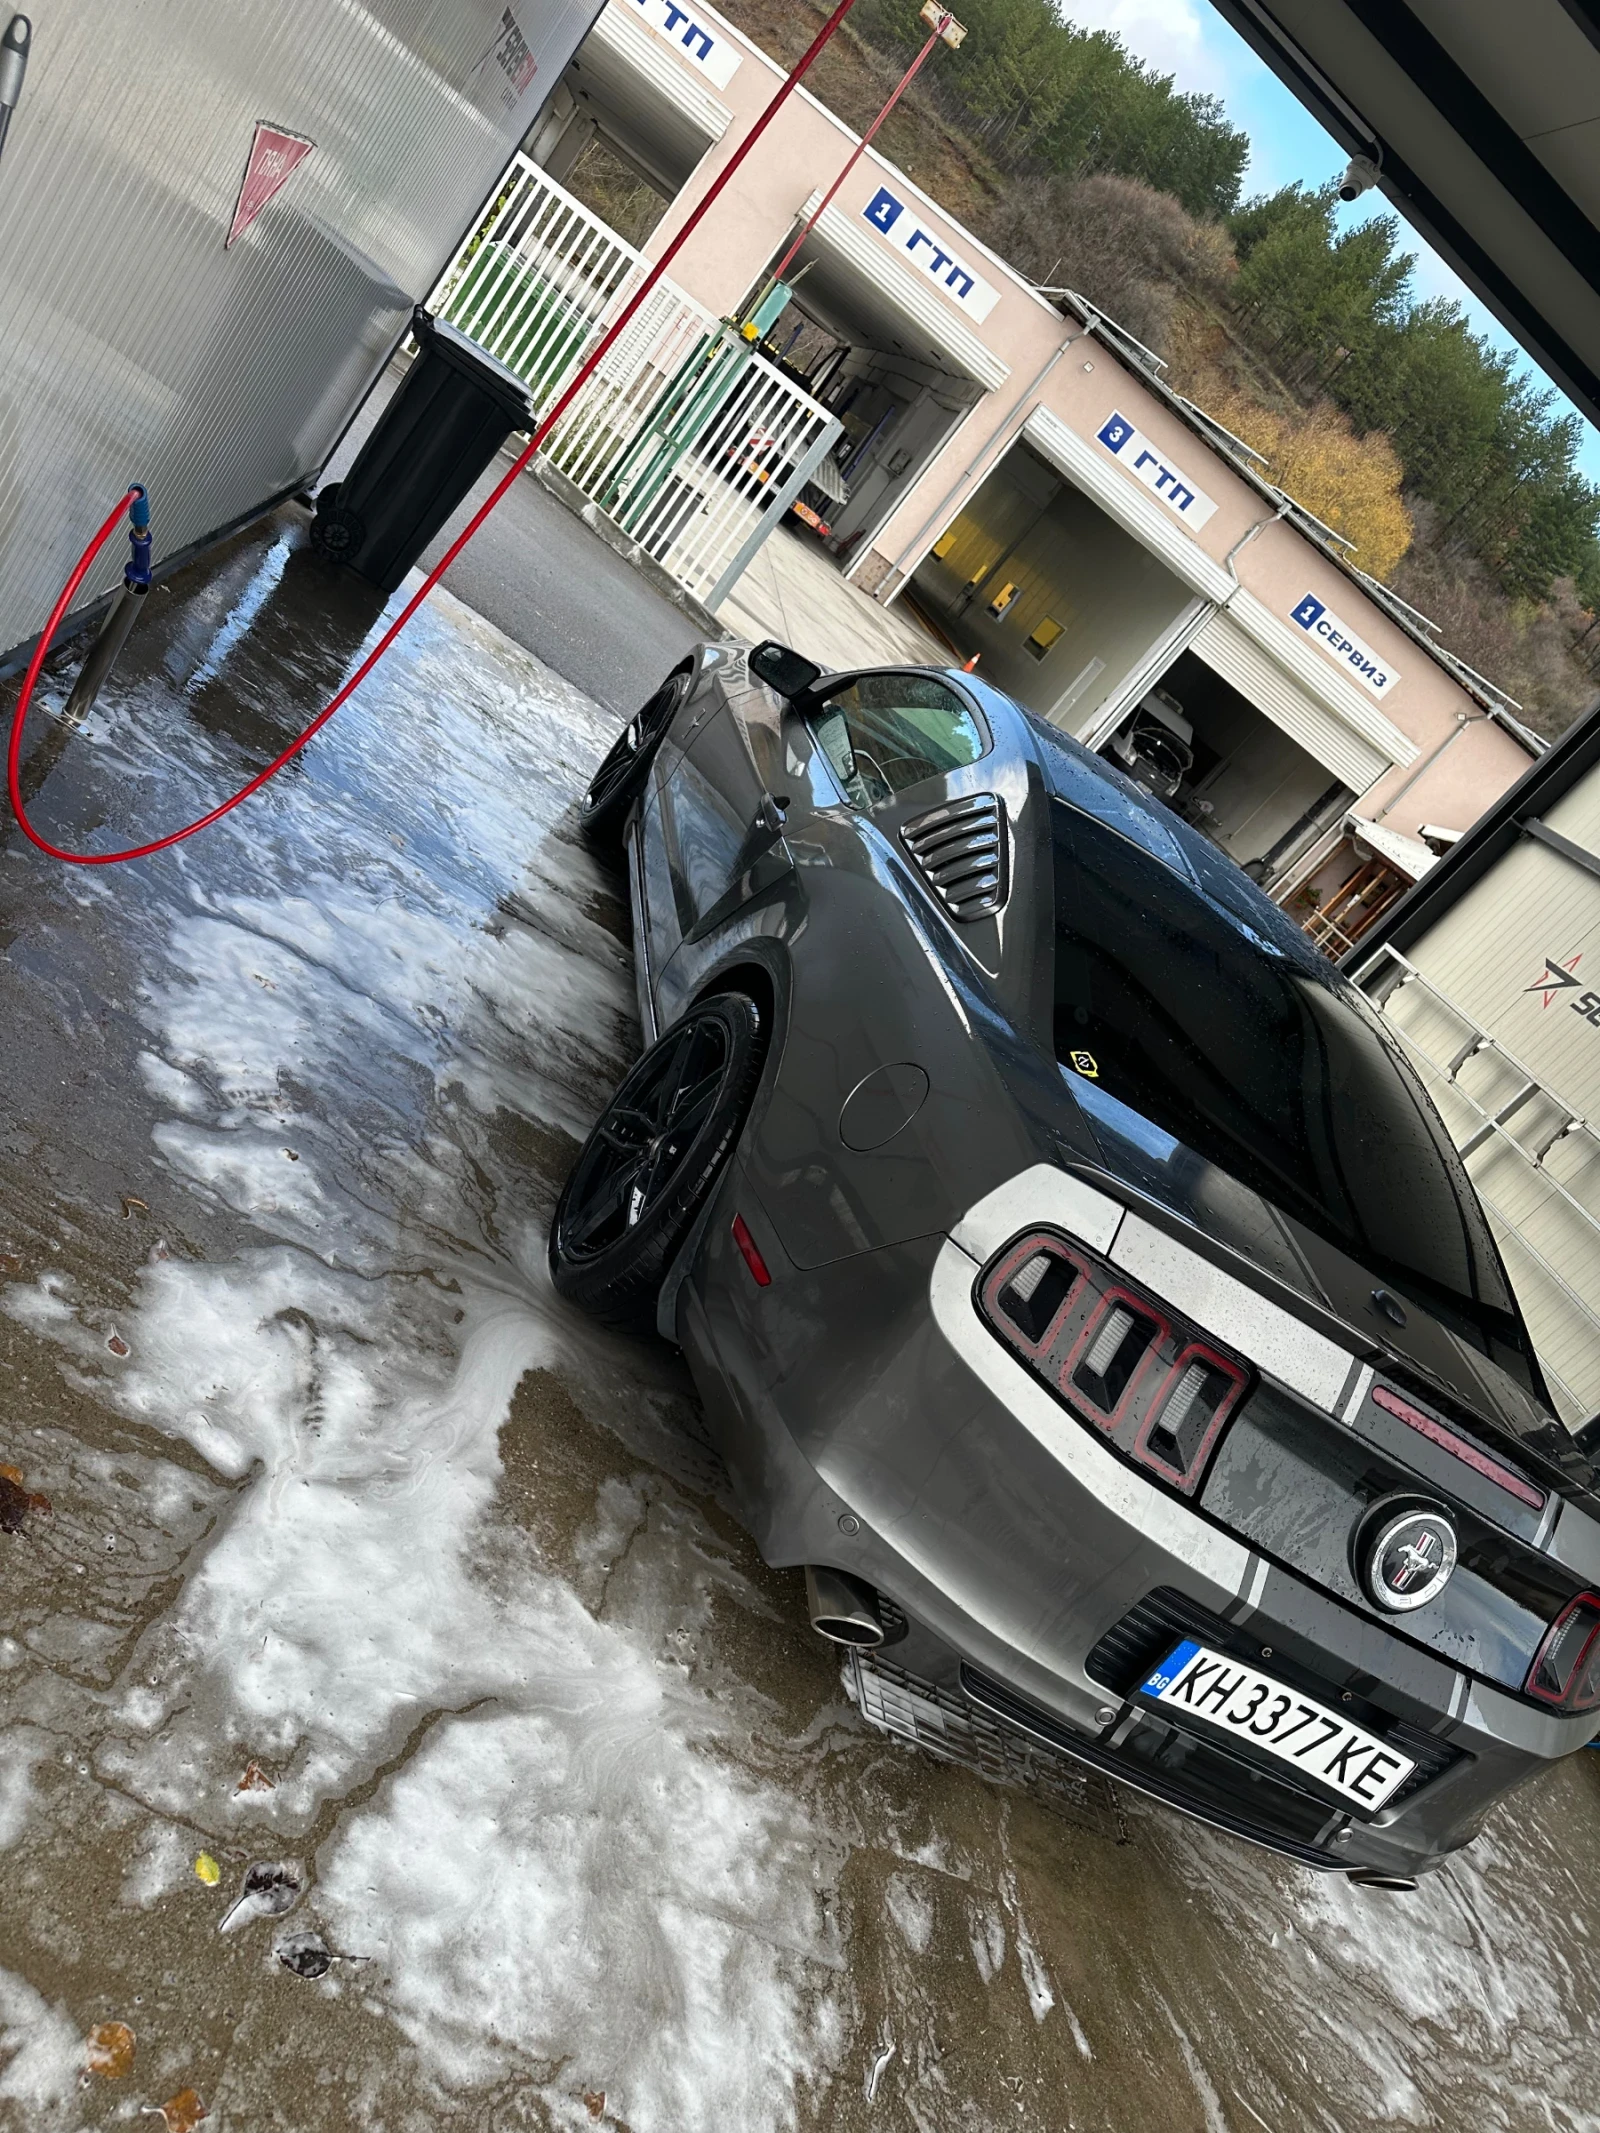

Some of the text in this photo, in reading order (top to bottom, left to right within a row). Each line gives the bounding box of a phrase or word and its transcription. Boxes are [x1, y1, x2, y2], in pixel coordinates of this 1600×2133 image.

[636, 0, 715, 62] ТП
[875, 202, 975, 299] 1 ГТП
[1108, 426, 1195, 512] 3 ГТП
[1299, 605, 1387, 687] 1 СЕРВИЗ
[1147, 1672, 1170, 1690] BG
